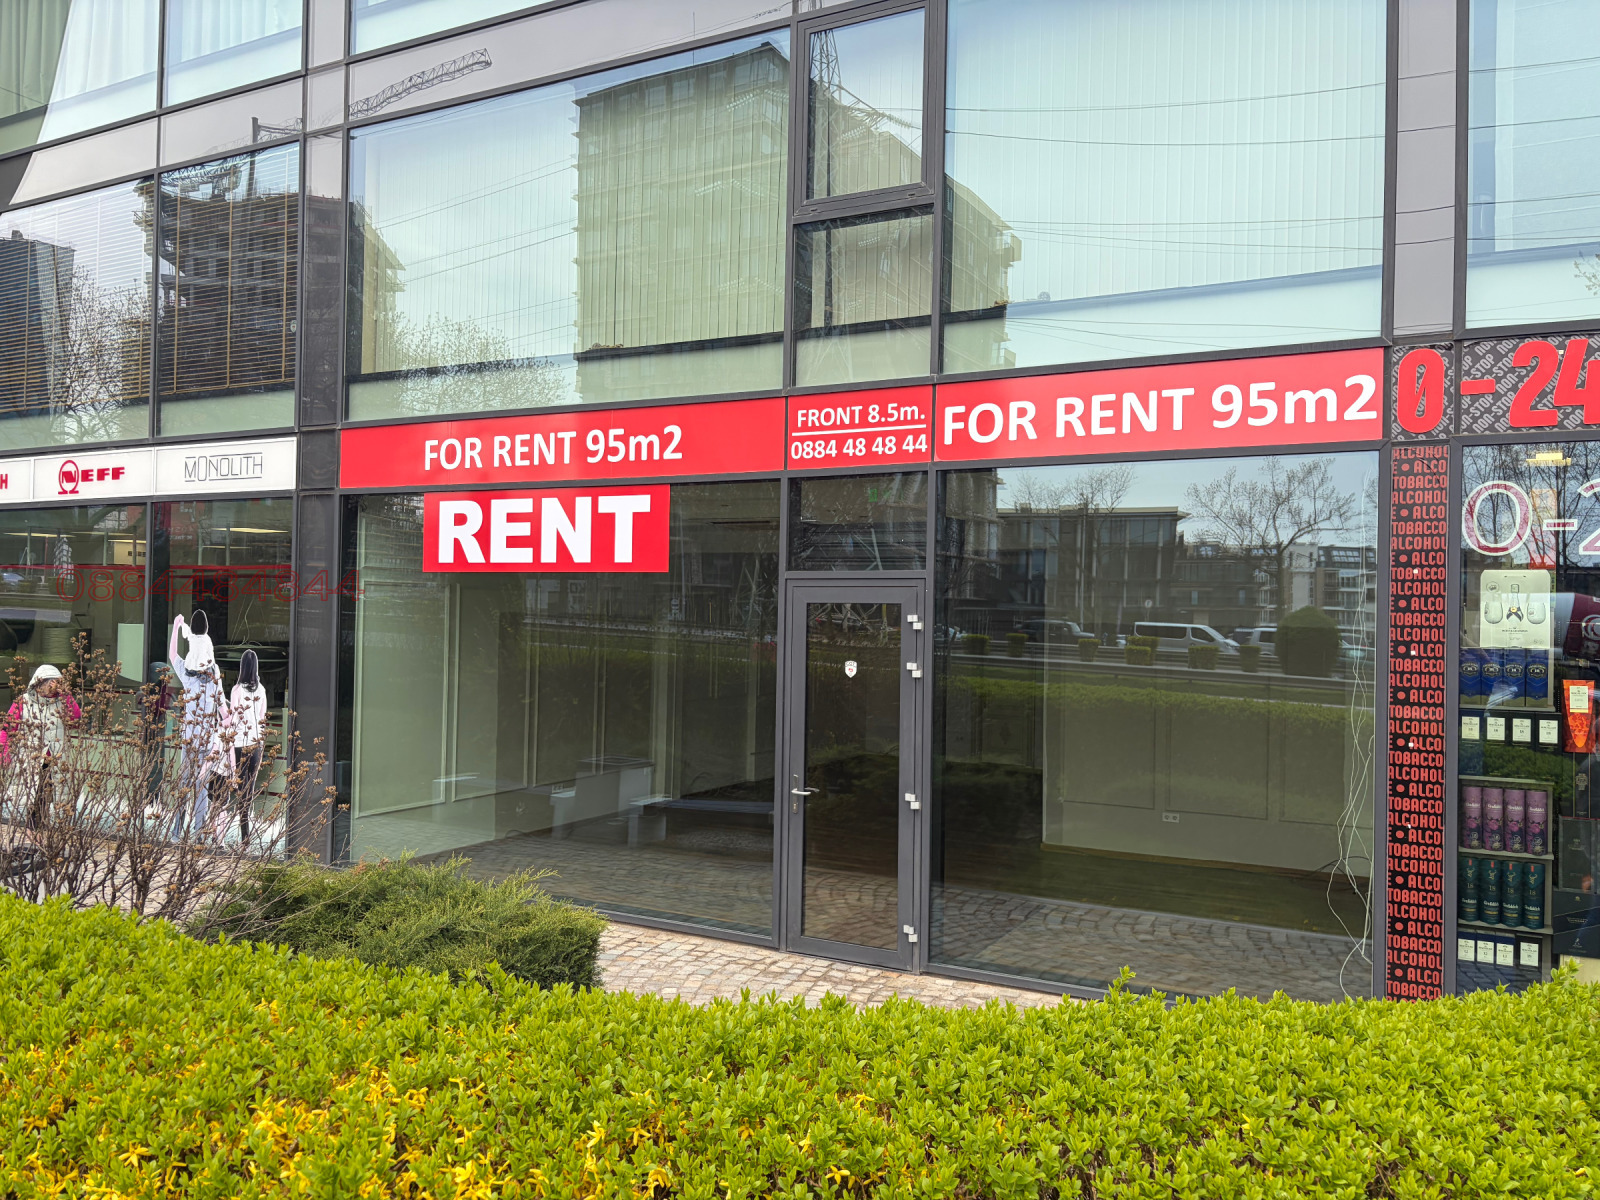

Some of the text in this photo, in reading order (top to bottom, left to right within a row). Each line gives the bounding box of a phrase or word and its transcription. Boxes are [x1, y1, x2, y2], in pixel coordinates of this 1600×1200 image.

[797, 403, 926, 428] FRONT 8.5m.
[945, 401, 1037, 445] FOR
[1056, 387, 1195, 438] RENT
[1211, 374, 1377, 429] 95m2
[424, 425, 683, 471] FOR RENT 95m2
[791, 433, 928, 460] 0884 48 48 44
[1393, 446, 1448, 460] ALCOHOL
[184, 452, 263, 484] MONOLITH
[1414, 459, 1447, 474] ALCO
[58, 459, 126, 495] NEFF
[1393, 475, 1447, 489] TOBACCO
[1392, 490, 1447, 505] ALCOHOL
[1413, 505, 1445, 519] ALCO
[438, 494, 651, 564] RENT
[1392, 521, 1446, 535] TOBACCO
[1391, 536, 1446, 550] ALCOHOL
[1411, 551, 1444, 565] ALCO
[1391, 567, 1446, 580] TOBACCO
[1391, 581, 1446, 596] ALCOHOL
[1411, 597, 1443, 611] ALCO
[1391, 612, 1445, 627] TOBACCO
[1390, 627, 1446, 642] ALCOHOL
[1390, 658, 1444, 673] TOBACCO
[1389, 673, 1445, 689] ALCOHOL
[1389, 705, 1443, 721] TOBACCO
[1389, 720, 1444, 736] ALCOHOL
[1389, 751, 1443, 767] TOBACCO
[1389, 766, 1444, 783] ALCOHOL
[1388, 797, 1442, 814] TOBACCO
[1388, 812, 1444, 830] ALCOHOL
[1388, 842, 1442, 861] TOBACCO
[1388, 858, 1443, 876] ALCOHOL
[1388, 888, 1442, 907] TOBACCO
[1388, 903, 1443, 923] ALCOHOL
[1387, 934, 1441, 954] TOBACCO
[1387, 950, 1443, 970] ALCOHOL
[1387, 980, 1441, 1001] TOBACCO
